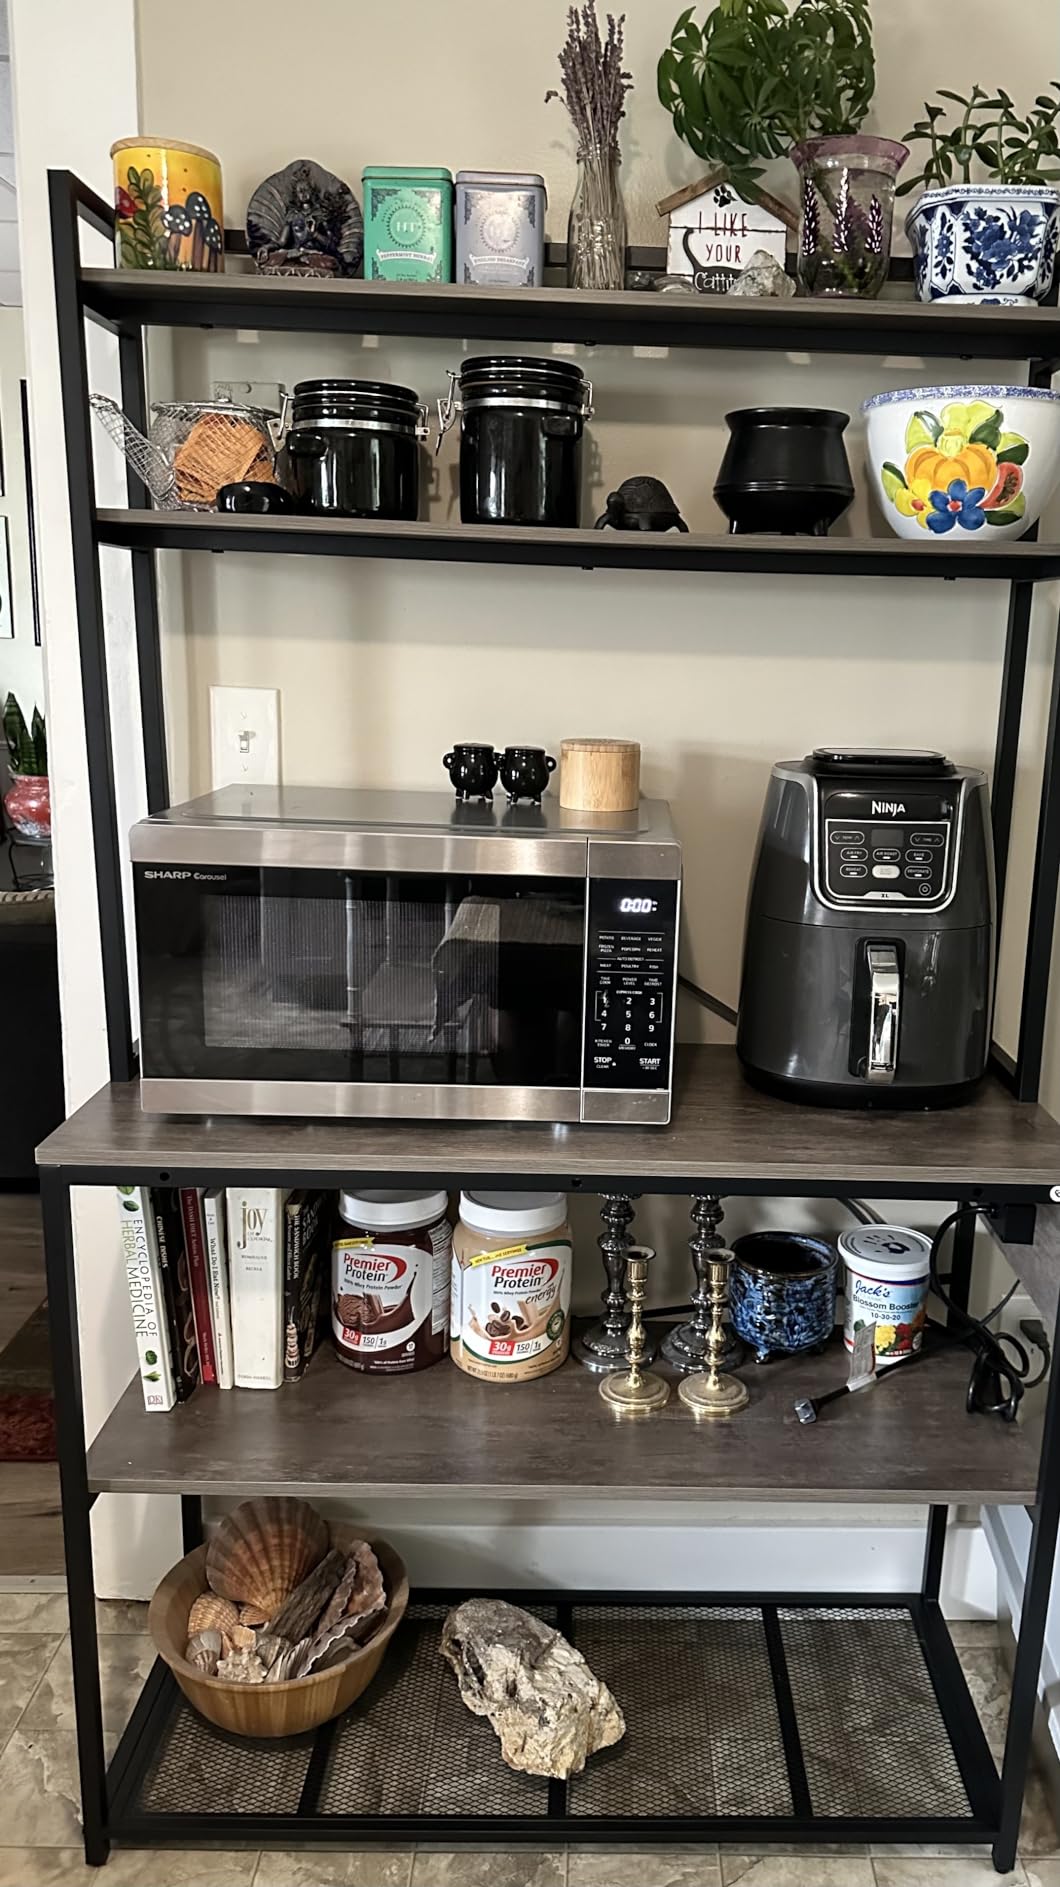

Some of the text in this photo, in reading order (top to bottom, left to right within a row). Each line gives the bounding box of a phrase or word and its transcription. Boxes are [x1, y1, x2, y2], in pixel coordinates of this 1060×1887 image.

[698, 211, 749, 238] I LIKE
[706, 244, 742, 263] YOUR
[695, 271, 737, 291] Cattit
[871, 800, 906, 817] NINJA
[144, 870, 227, 881] SHARP Carousel
[626, 997, 632, 1005] 2
[649, 997, 656, 1006] 3
[601, 1009, 607, 1018] 4
[625, 1010, 632, 1019] 5
[648, 1011, 656, 1019] 6
[601, 1022, 607, 1031] 7
[624, 1023, 632, 1032] 8
[648, 1024, 655, 1032] 9
[624, 1036, 631, 1045] 0
[639, 1057, 661, 1065] START
[236, 1200, 269, 1249] joy
[344, 1253, 391, 1271] Premier
[345, 1264, 386, 1282] Protein
[491, 1264, 548, 1278] Premier
[120, 1220, 149, 1337] HERBAL MEDICINE
[133, 1219, 158, 1337] ENCYCLOPEDIA OF
[494, 1275, 542, 1289] Protein
[525, 1282, 557, 1305] energy
[855, 1280, 891, 1298] Jack's
[853, 1294, 887, 1310] Blossom
[871, 1312, 901, 1321] 10-30-20
[343, 1327, 359, 1341] 30g
[363, 1336, 375, 1345] 150
[379, 1337, 387, 1345] 1g
[534, 1341, 541, 1350] 1g
[493, 1341, 512, 1352] 30g
[516, 1342, 531, 1351] 150
